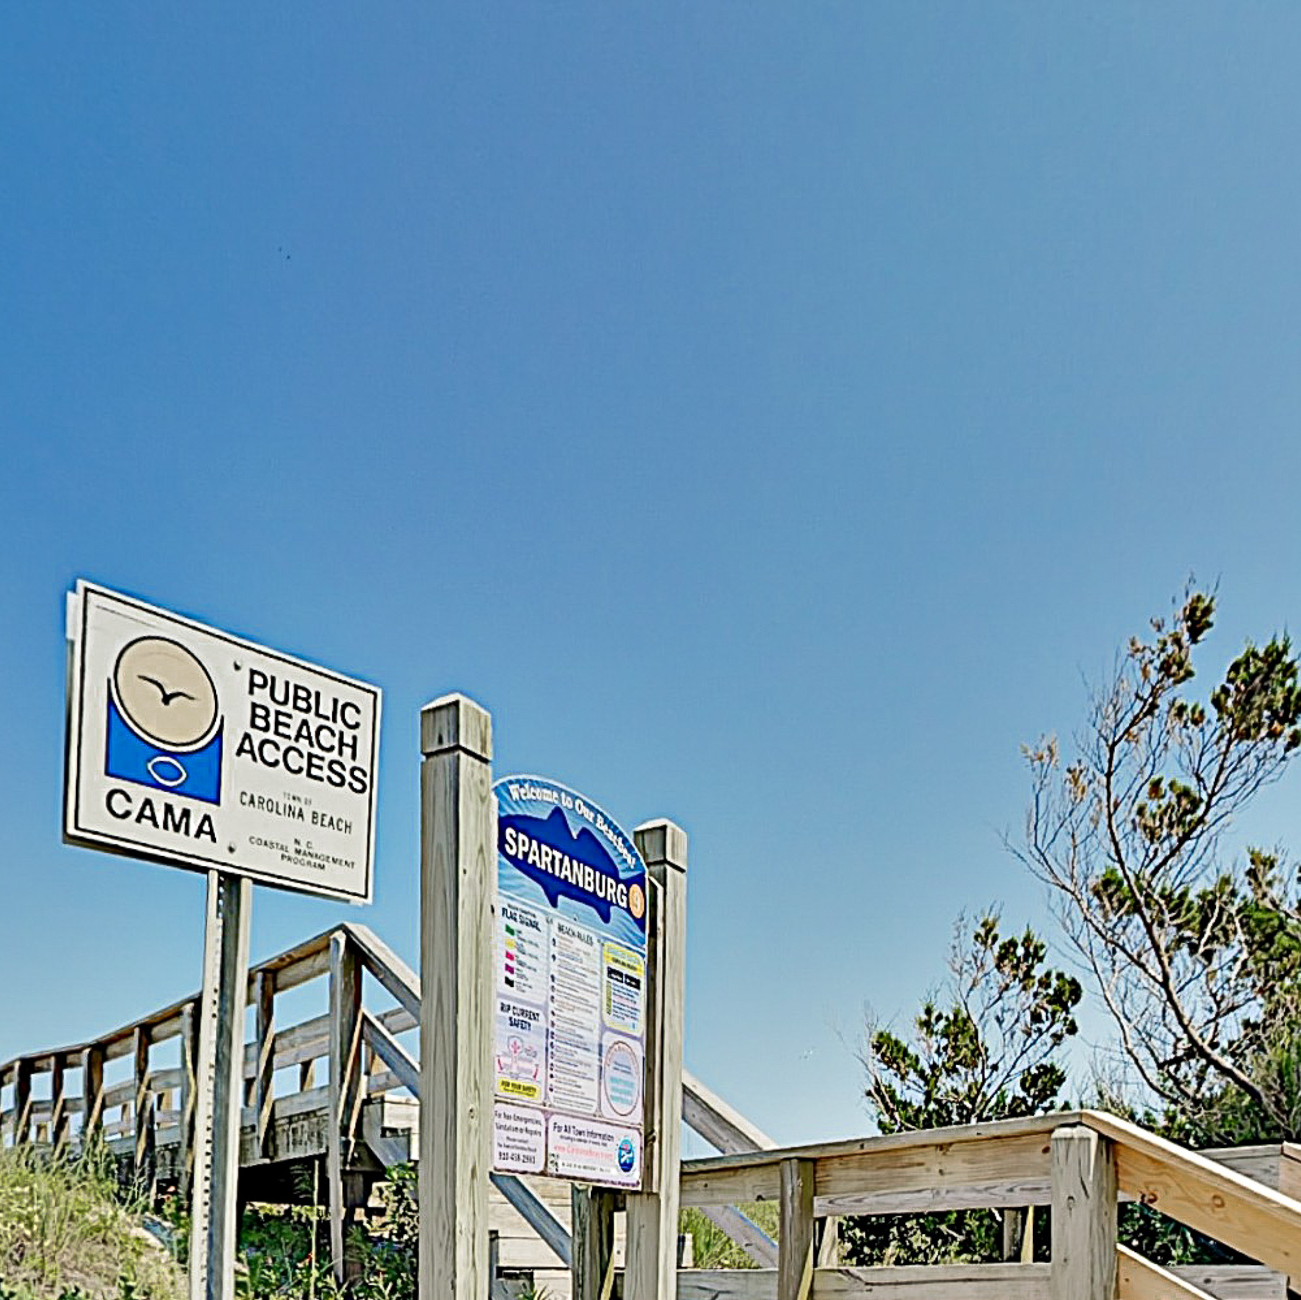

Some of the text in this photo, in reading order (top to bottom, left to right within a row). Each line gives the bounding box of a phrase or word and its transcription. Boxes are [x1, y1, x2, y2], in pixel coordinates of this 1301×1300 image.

[248, 668, 361, 730] PUBLIC
[250, 701, 357, 762] BEACH
[235, 732, 368, 794] ACCESS
[105, 788, 217, 843] CAMA
[240, 791, 353, 834] CAROLINA BEACH
[509, 783, 559, 804] Welcome
[560, 792, 573, 810] to
[574, 799, 595, 823] Our
[248, 836, 355, 869] COASTAL MANAGEMENT
[280, 854, 325, 870] PROGRAM
[504, 827, 628, 909] SPARTANBURG
[508, 1016, 532, 1031] SAFETY
[553, 1122, 562, 1133] For
[572, 1126, 585, 1138] Town
